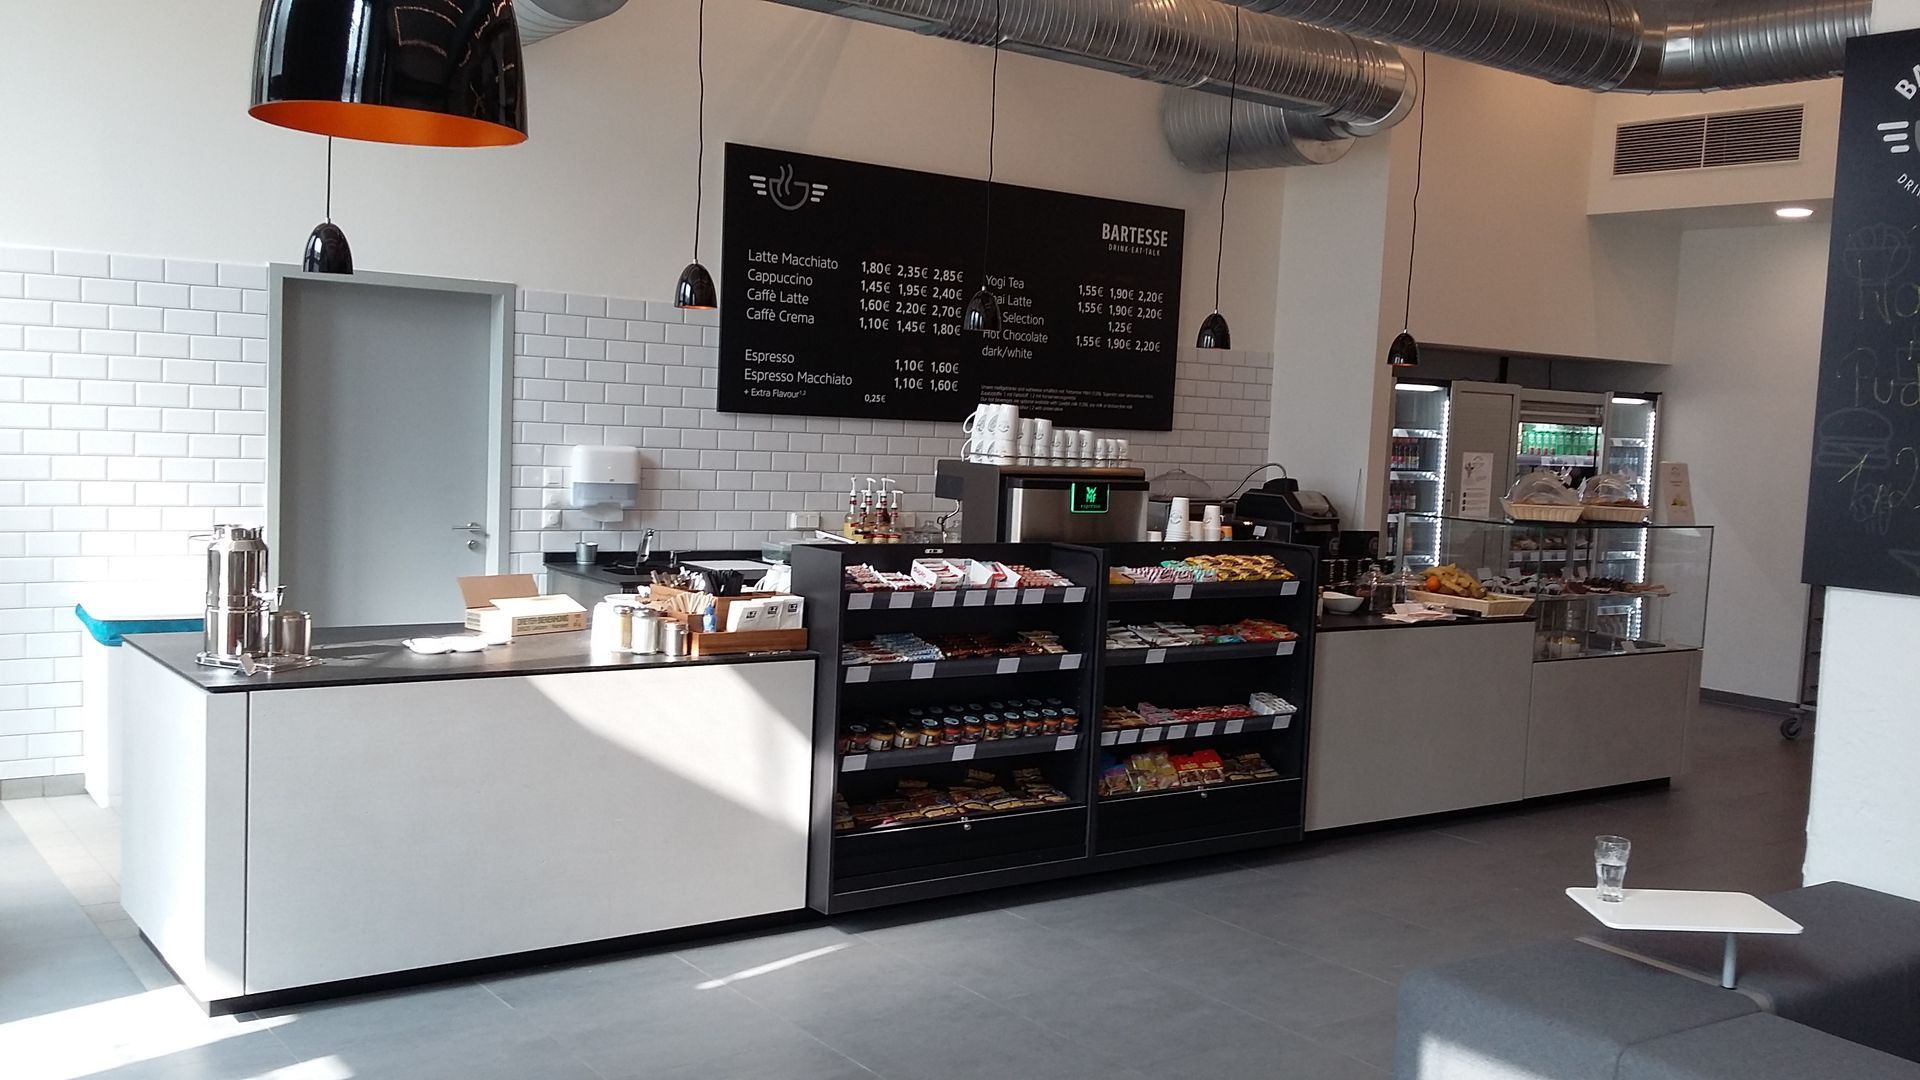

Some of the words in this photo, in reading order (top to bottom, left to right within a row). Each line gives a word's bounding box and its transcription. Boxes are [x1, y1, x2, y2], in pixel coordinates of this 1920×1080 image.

[1101, 223, 1168, 247] BARTESSE
[747, 249, 778, 263] Latte
[781, 253, 838, 270] Macchiato
[860, 261, 891, 275] 1,80€
[897, 266, 928, 279] 2,35€
[933, 269, 963, 282] 2,85€
[747, 269, 813, 286] Cappuccino
[860, 280, 891, 294] 1,45€
[897, 284, 927, 297] 1,95€
[932, 288, 962, 300] 2,40€
[984, 275, 1006, 290] Yogi
[1008, 277, 1024, 289] Tea
[1078, 285, 1103, 297] 1,55€
[1109, 288, 1134, 300] 1,90€
[1138, 291, 1163, 304] 2,20€
[746, 289, 776, 302] Caffè
[779, 292, 809, 305] Latte
[859, 299, 890, 312] 1,60€
[895, 302, 926, 315] 2,20€
[931, 305, 962, 318] 2,70€
[1007, 296, 1032, 308] Latte
[1077, 302, 1102, 314] 1,55€
[1108, 305, 1133, 317] 1,90€
[1137, 308, 1162, 320] 2,20€
[745, 308, 775, 321] Caffè
[778, 311, 814, 325] Crema
[858, 318, 889, 331] 1,10€
[896, 321, 925, 334] 1,45€
[932, 323, 961, 336] 1,80€
[1002, 312, 1044, 325] Selection
[1107, 322, 1132, 334] 1,25€
[982, 328, 1001, 339] Hot
[1002, 330, 1048, 343] Chocolate
[1075, 336, 1101, 347] 1,55€
[1106, 338, 1131, 350] 1,90€
[1134, 341, 1160, 352] 2,20€
[744, 349, 794, 364] Espresso
[894, 360, 924, 372] 1,10€
[930, 362, 959, 374] 1,60€
[981, 346, 1032, 359] dark/white
[744, 369, 794, 383] Espresso
[796, 372, 853, 386] Macchiato
[893, 378, 923, 390] 1,10€
[929, 380, 958, 392] 1,60€
[750, 389, 770, 397] Extra
[863, 394, 886, 403] 0,25€
